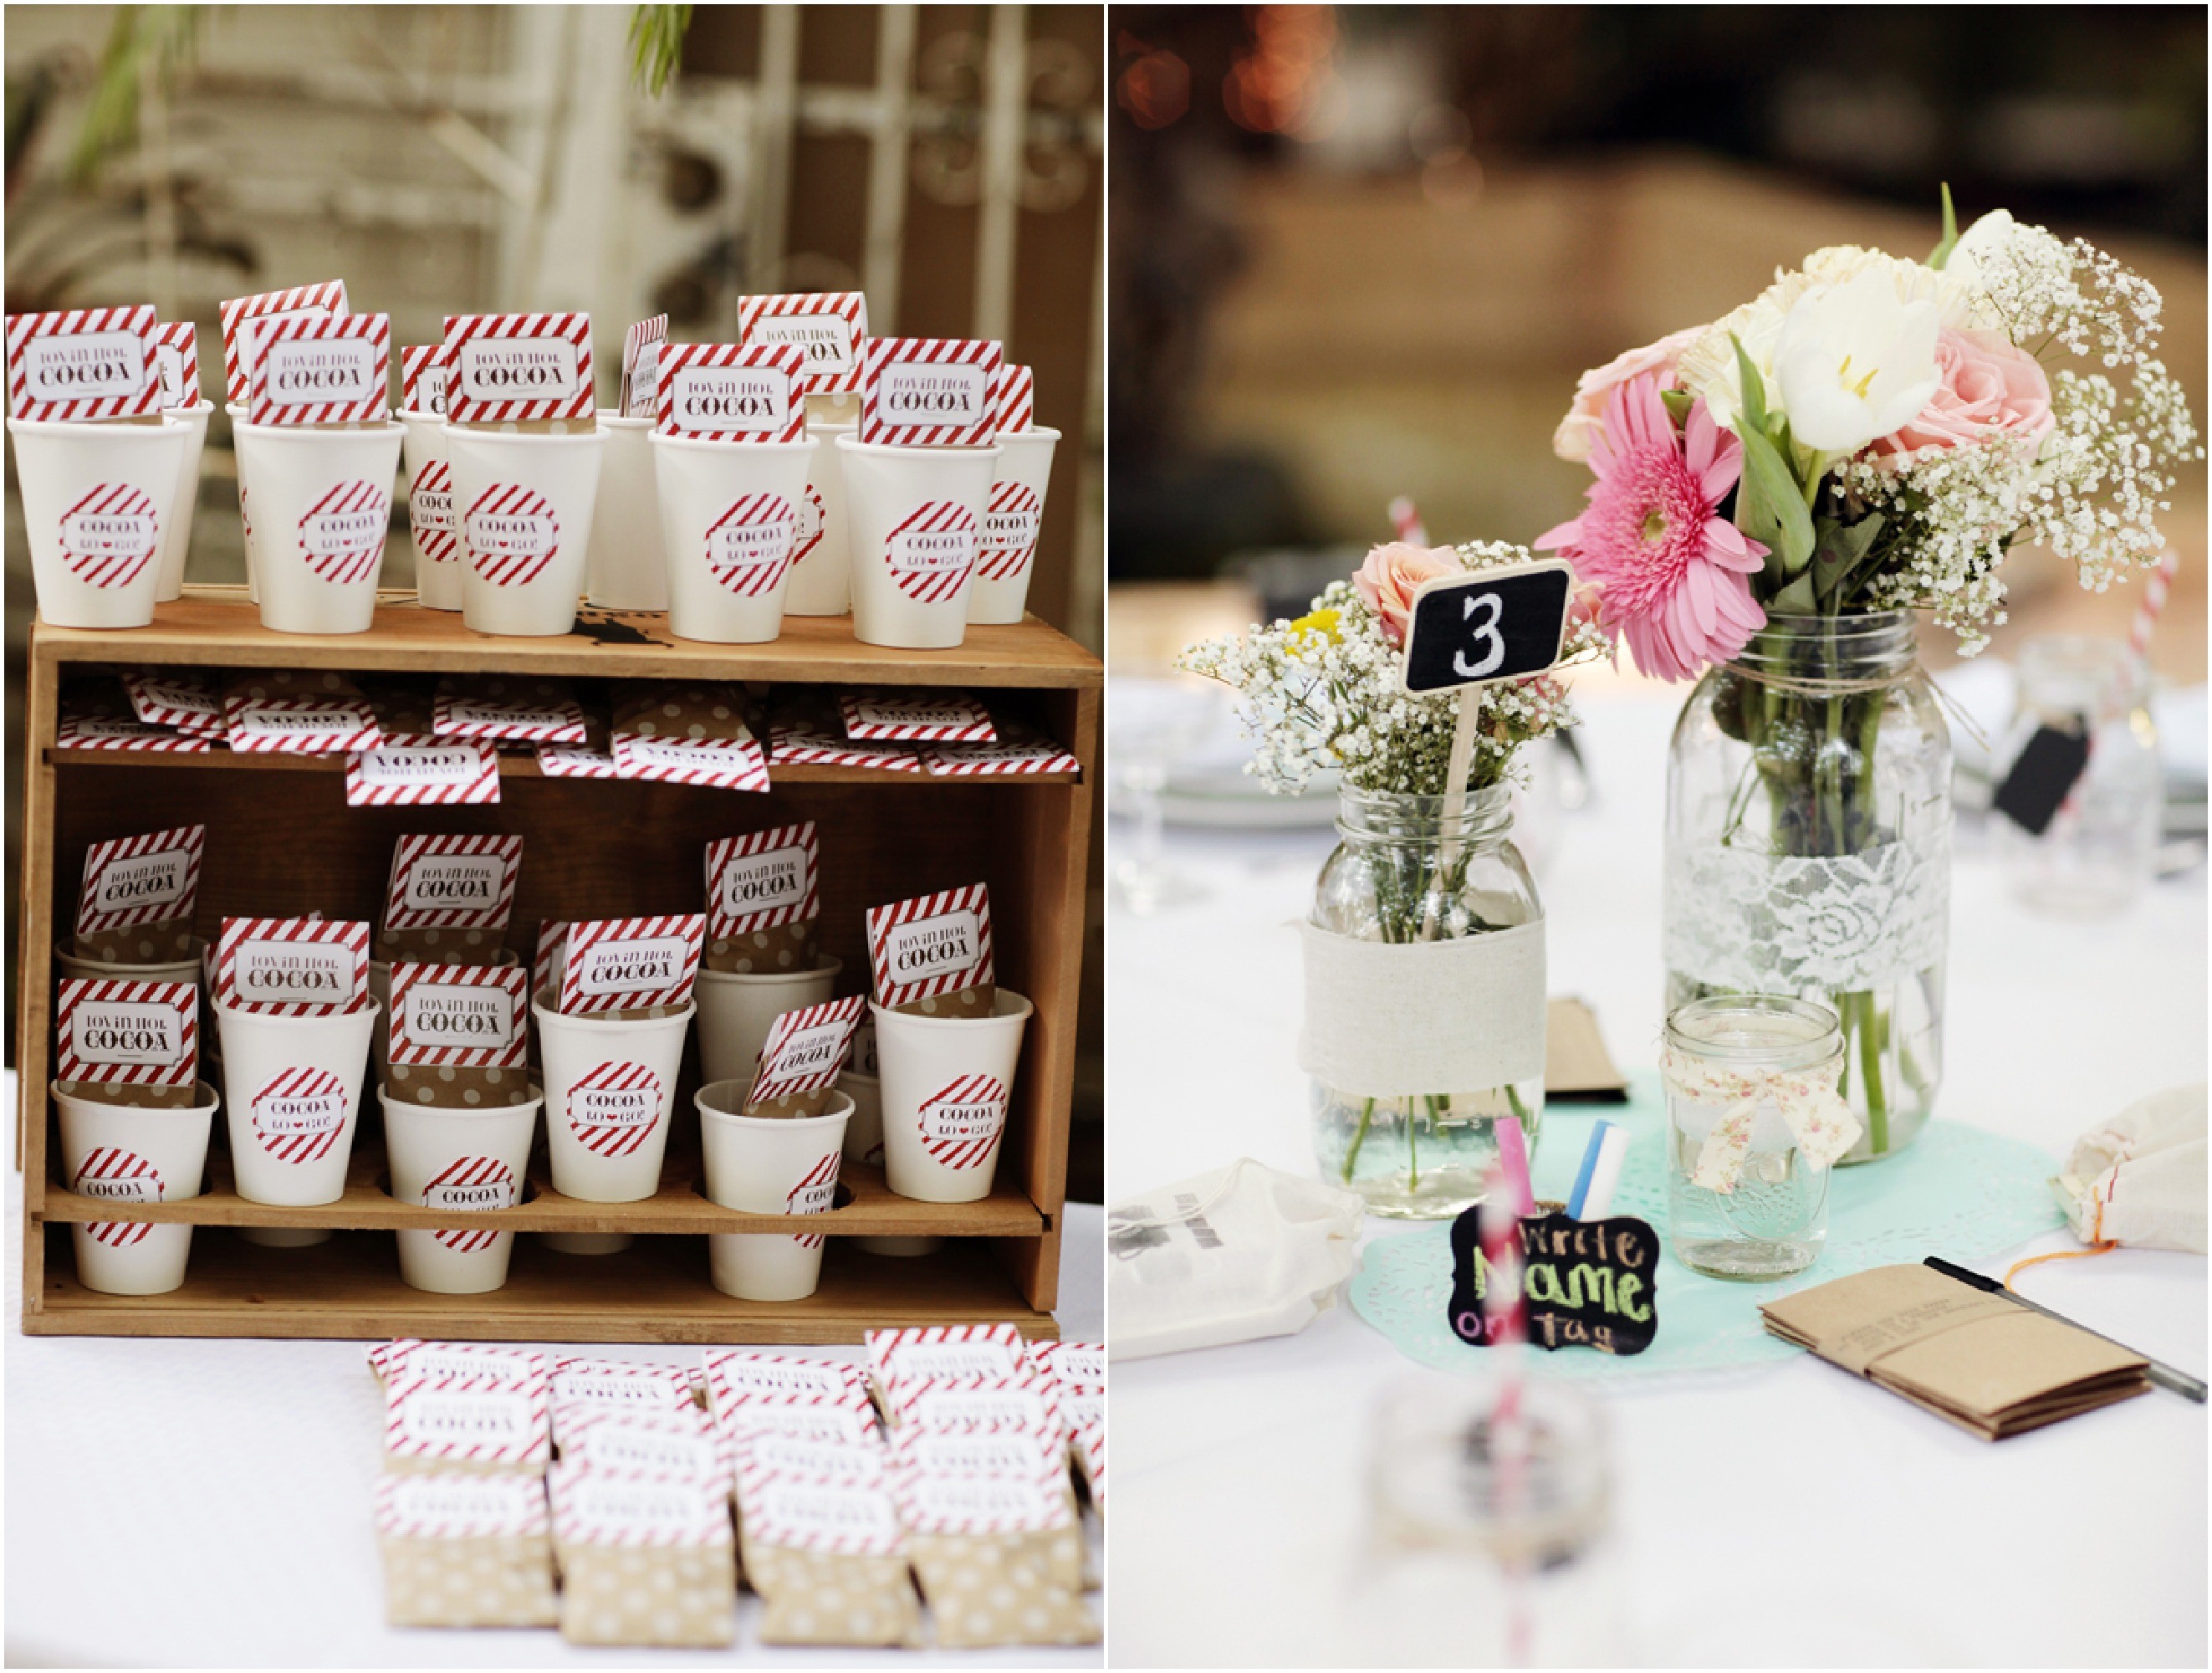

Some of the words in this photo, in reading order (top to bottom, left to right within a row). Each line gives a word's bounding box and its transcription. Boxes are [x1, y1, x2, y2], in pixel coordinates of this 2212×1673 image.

[39, 362, 131, 386] COCOA
[278, 369, 360, 390] COCOA
[473, 366, 565, 386] COCOA
[685, 396, 776, 416] COCOA
[889, 391, 973, 412] COCOA
[79, 520, 140, 533] COCOA
[320, 516, 375, 533] COCOA
[479, 519, 538, 534] COCOA
[725, 528, 782, 545] COCOA
[907, 536, 963, 550] COCOA
[1453, 592, 1505, 677] 3
[105, 874, 176, 902] COCOA
[416, 880, 490, 898] COCOA
[731, 873, 797, 905] COCOA
[897, 938, 970, 970] COCOA
[248, 969, 341, 990] COCOA
[591, 962, 672, 984] COCOA
[416, 1011, 502, 1036] COCOA
[84, 1029, 172, 1052] COCOA
[270, 1099, 330, 1117] COCOA
[585, 1092, 646, 1109] COCOA
[938, 1107, 994, 1122] COCOA
[85, 1181, 144, 1197] COCOA
[442, 1187, 501, 1204] COCOA
[1473, 1244, 1654, 1323] Name
